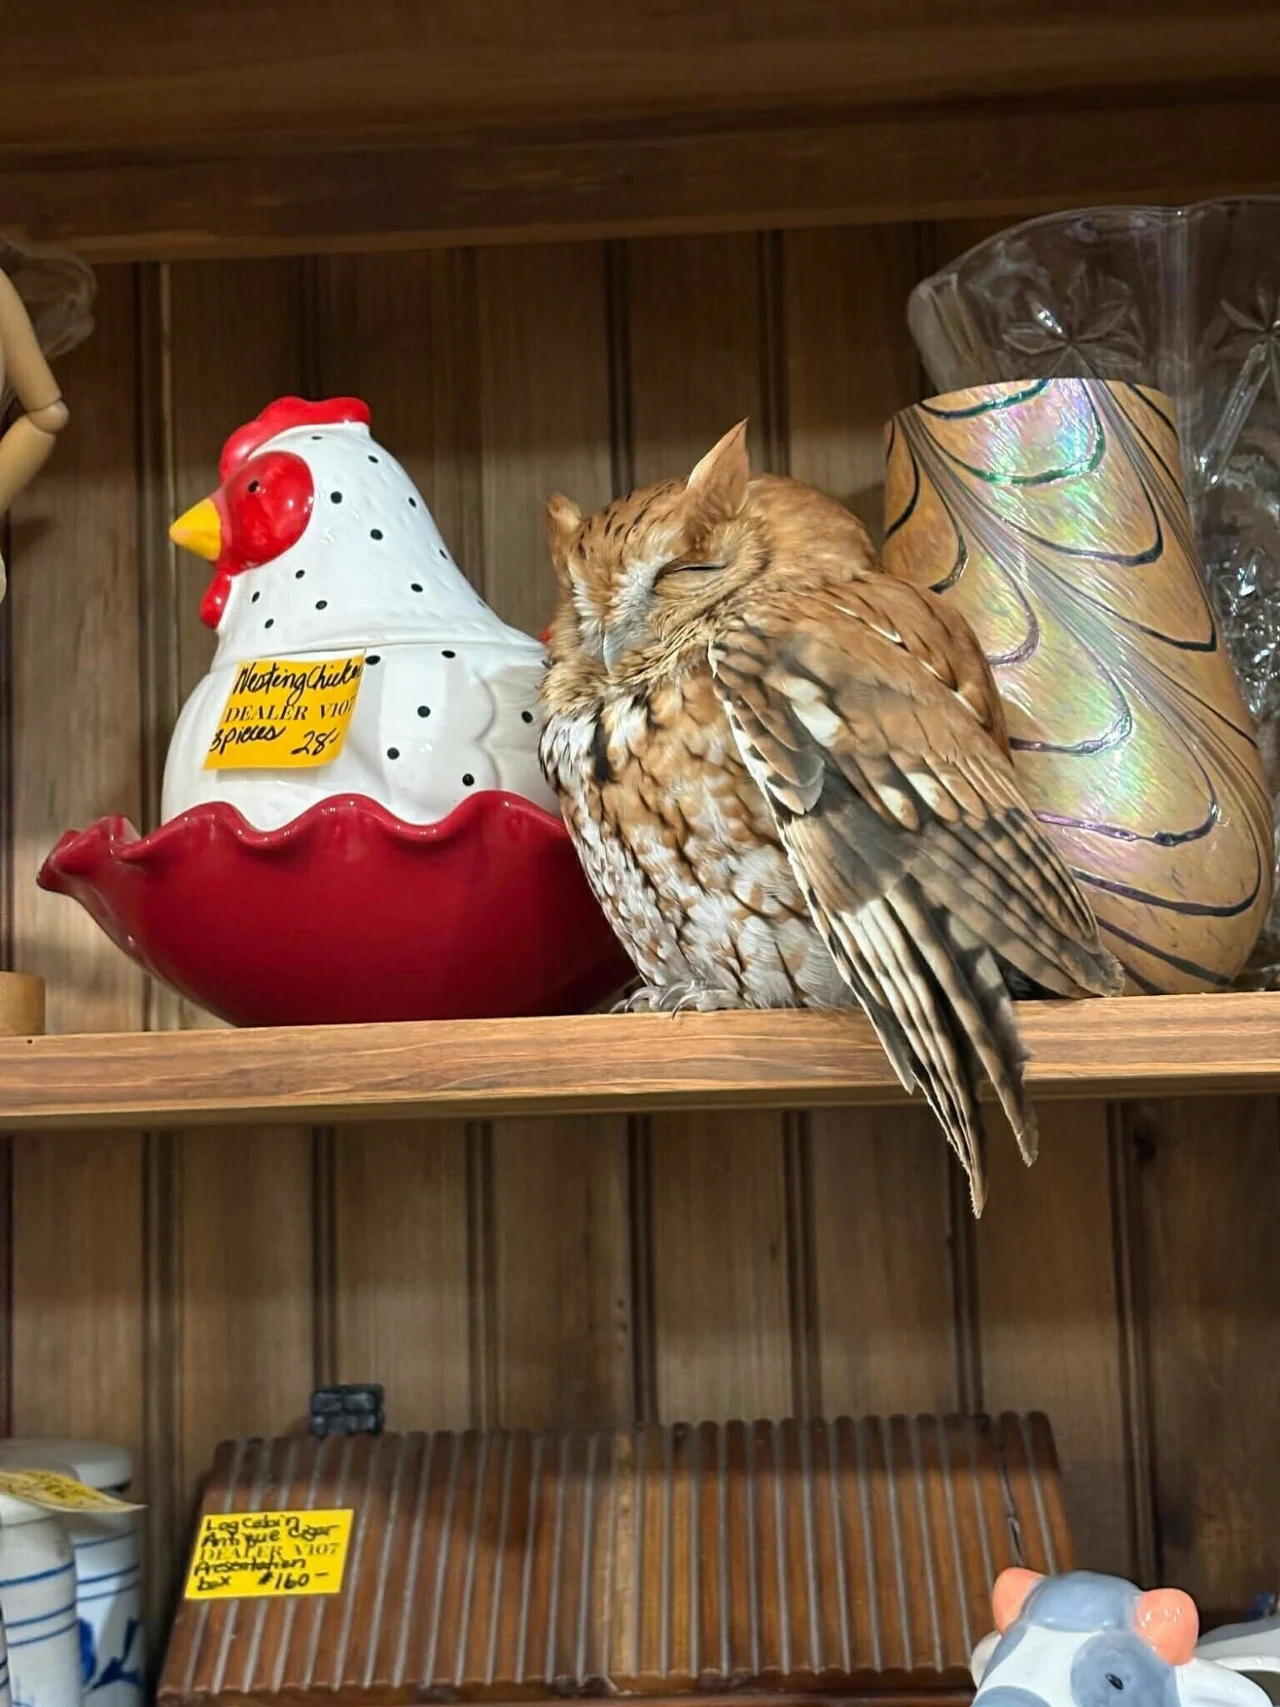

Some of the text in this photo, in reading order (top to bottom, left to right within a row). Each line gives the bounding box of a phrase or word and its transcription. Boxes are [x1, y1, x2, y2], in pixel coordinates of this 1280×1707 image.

[233, 662, 307, 706] Nesting
[224, 704, 309, 722] DEALER
[206, 1514, 300, 1534] Log Cabin
[201, 1530, 281, 1549] Antique
[200, 1545, 283, 1560] DEALER
[197, 1575, 231, 1591] box
